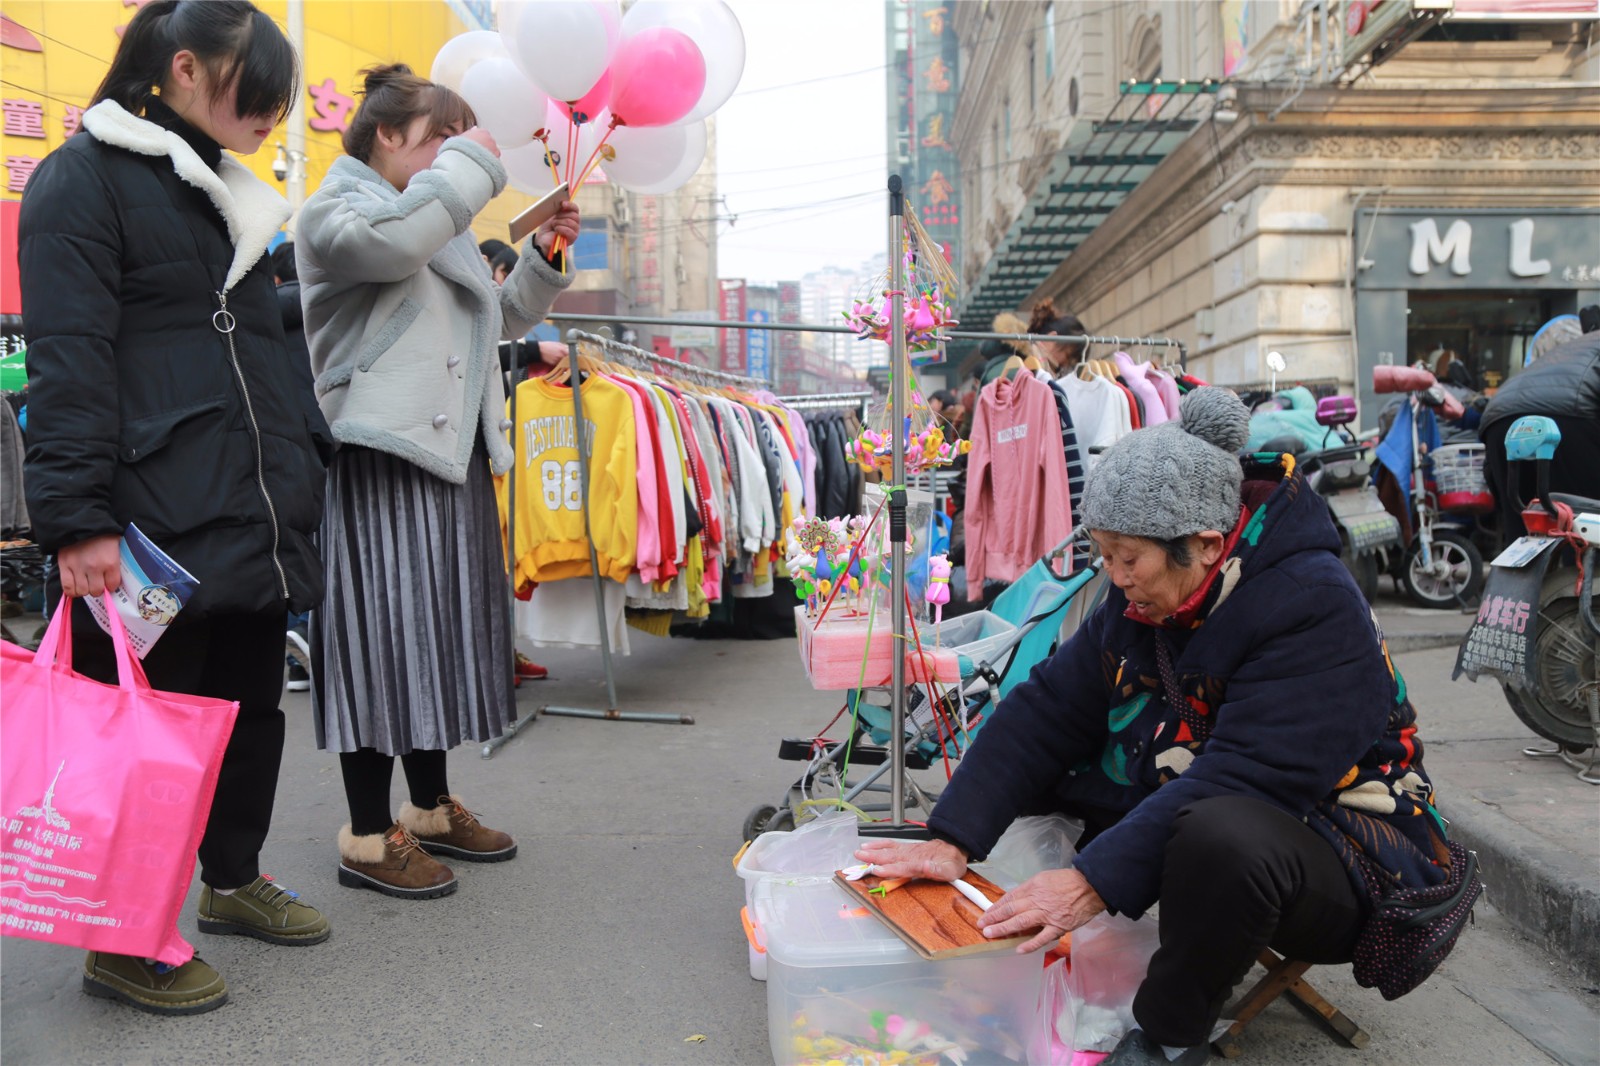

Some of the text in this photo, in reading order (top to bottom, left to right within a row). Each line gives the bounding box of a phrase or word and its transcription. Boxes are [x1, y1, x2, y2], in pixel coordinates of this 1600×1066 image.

[1409, 217, 1551, 277] M L
[541, 459, 582, 511] 88
